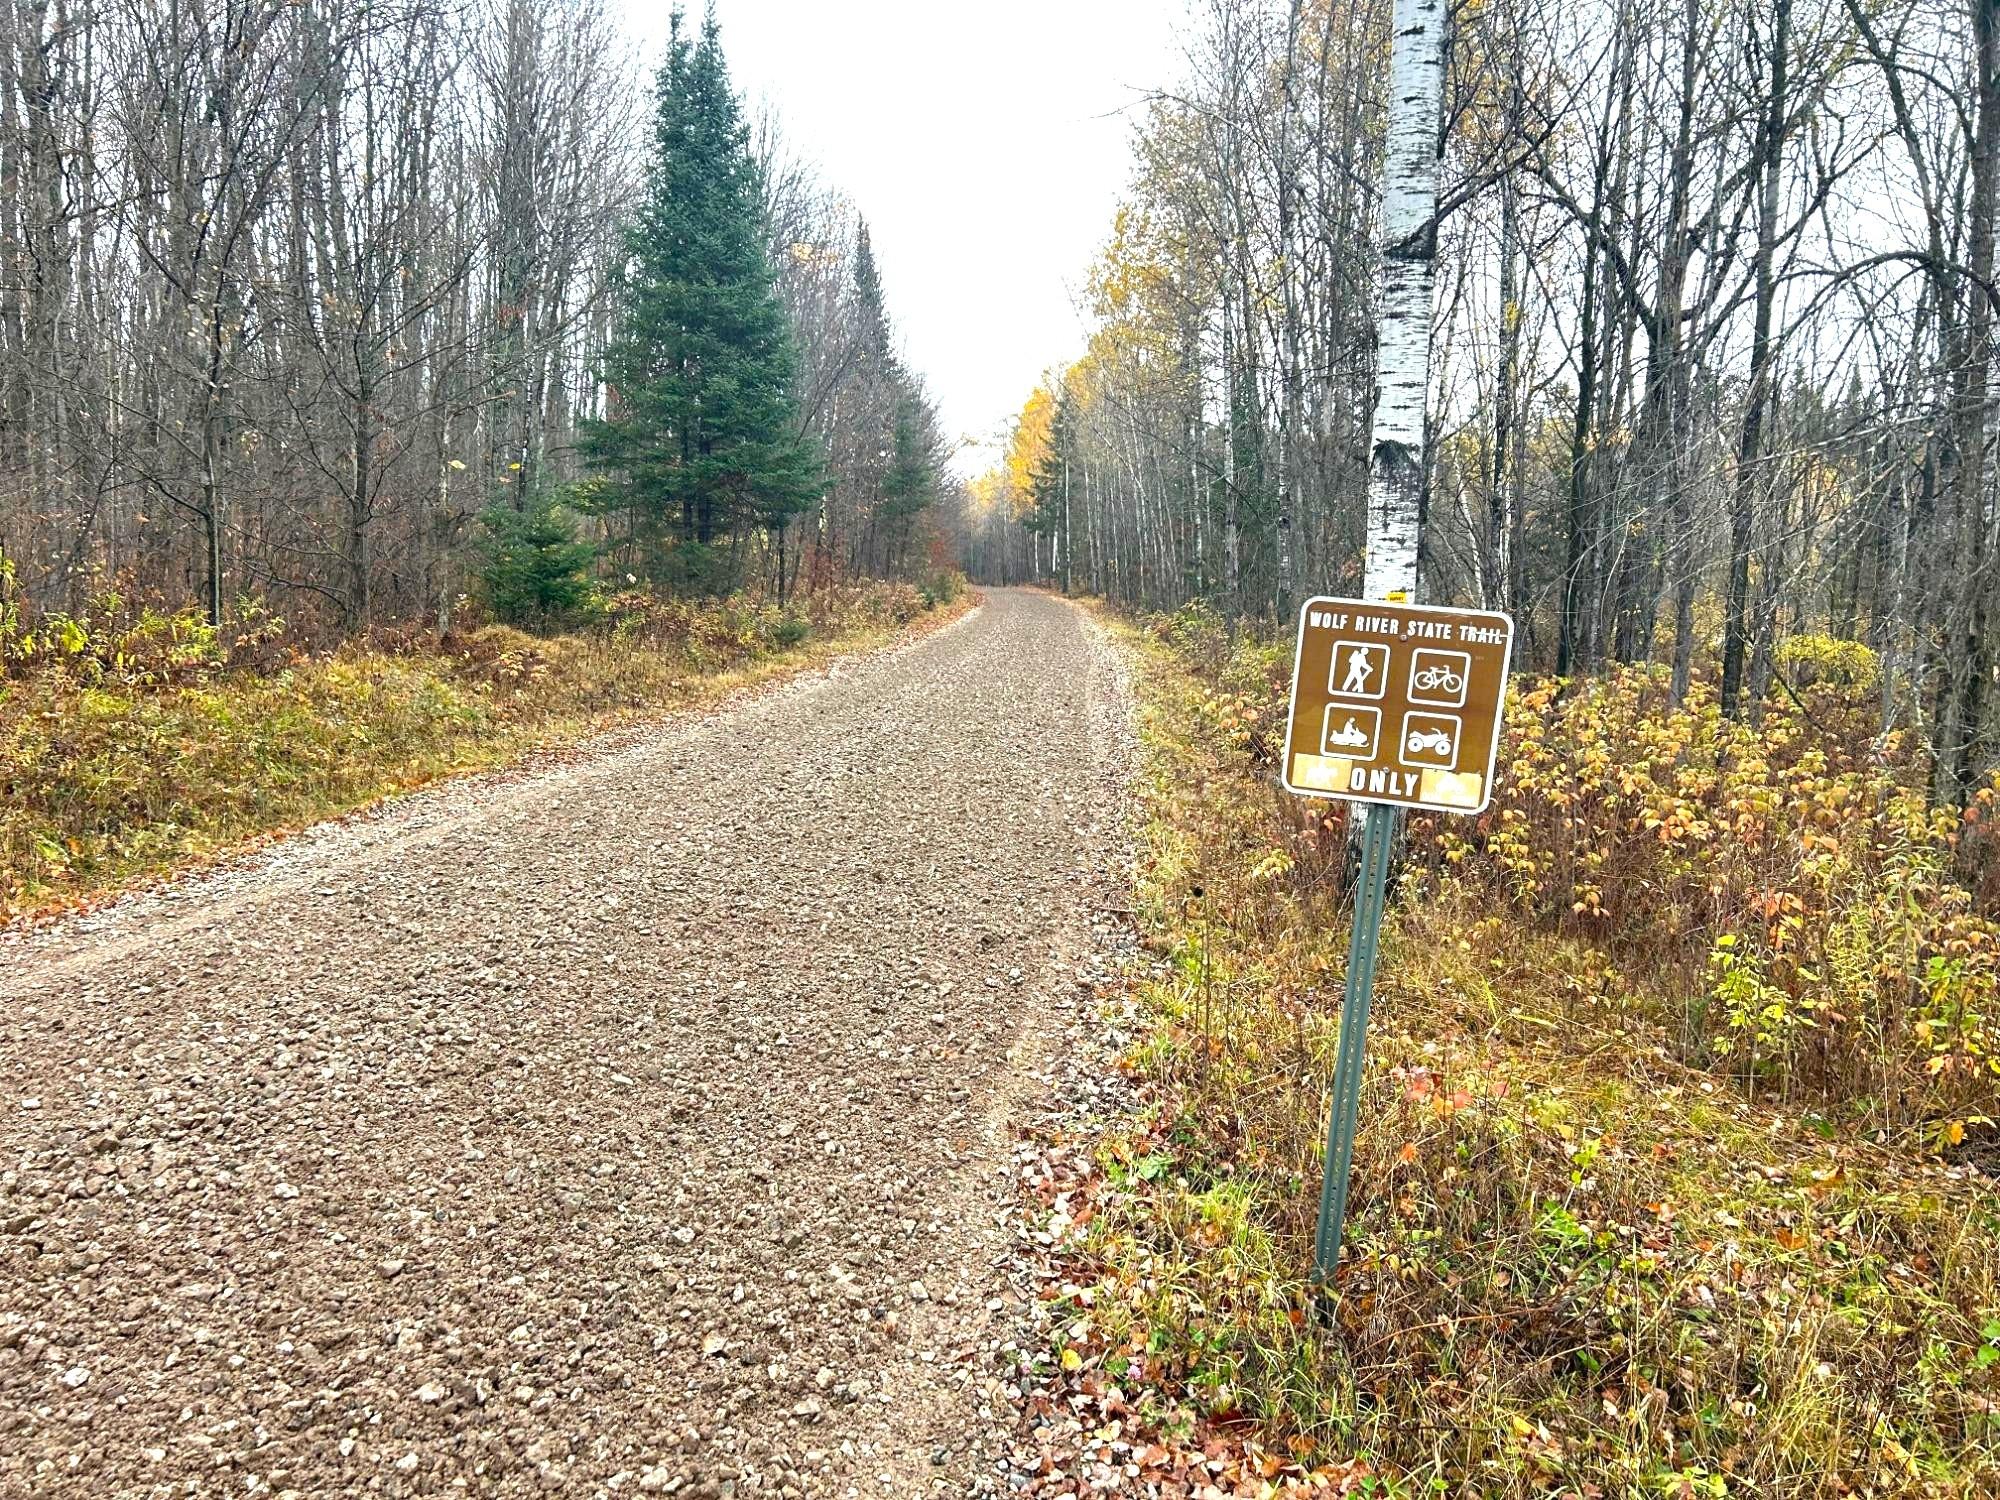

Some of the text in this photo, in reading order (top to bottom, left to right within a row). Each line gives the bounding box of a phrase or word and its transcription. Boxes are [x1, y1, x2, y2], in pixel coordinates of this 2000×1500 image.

[1310, 611, 1503, 645] WOLF RIVER STATE TRAIL
[1351, 767, 1419, 797] ONLY
